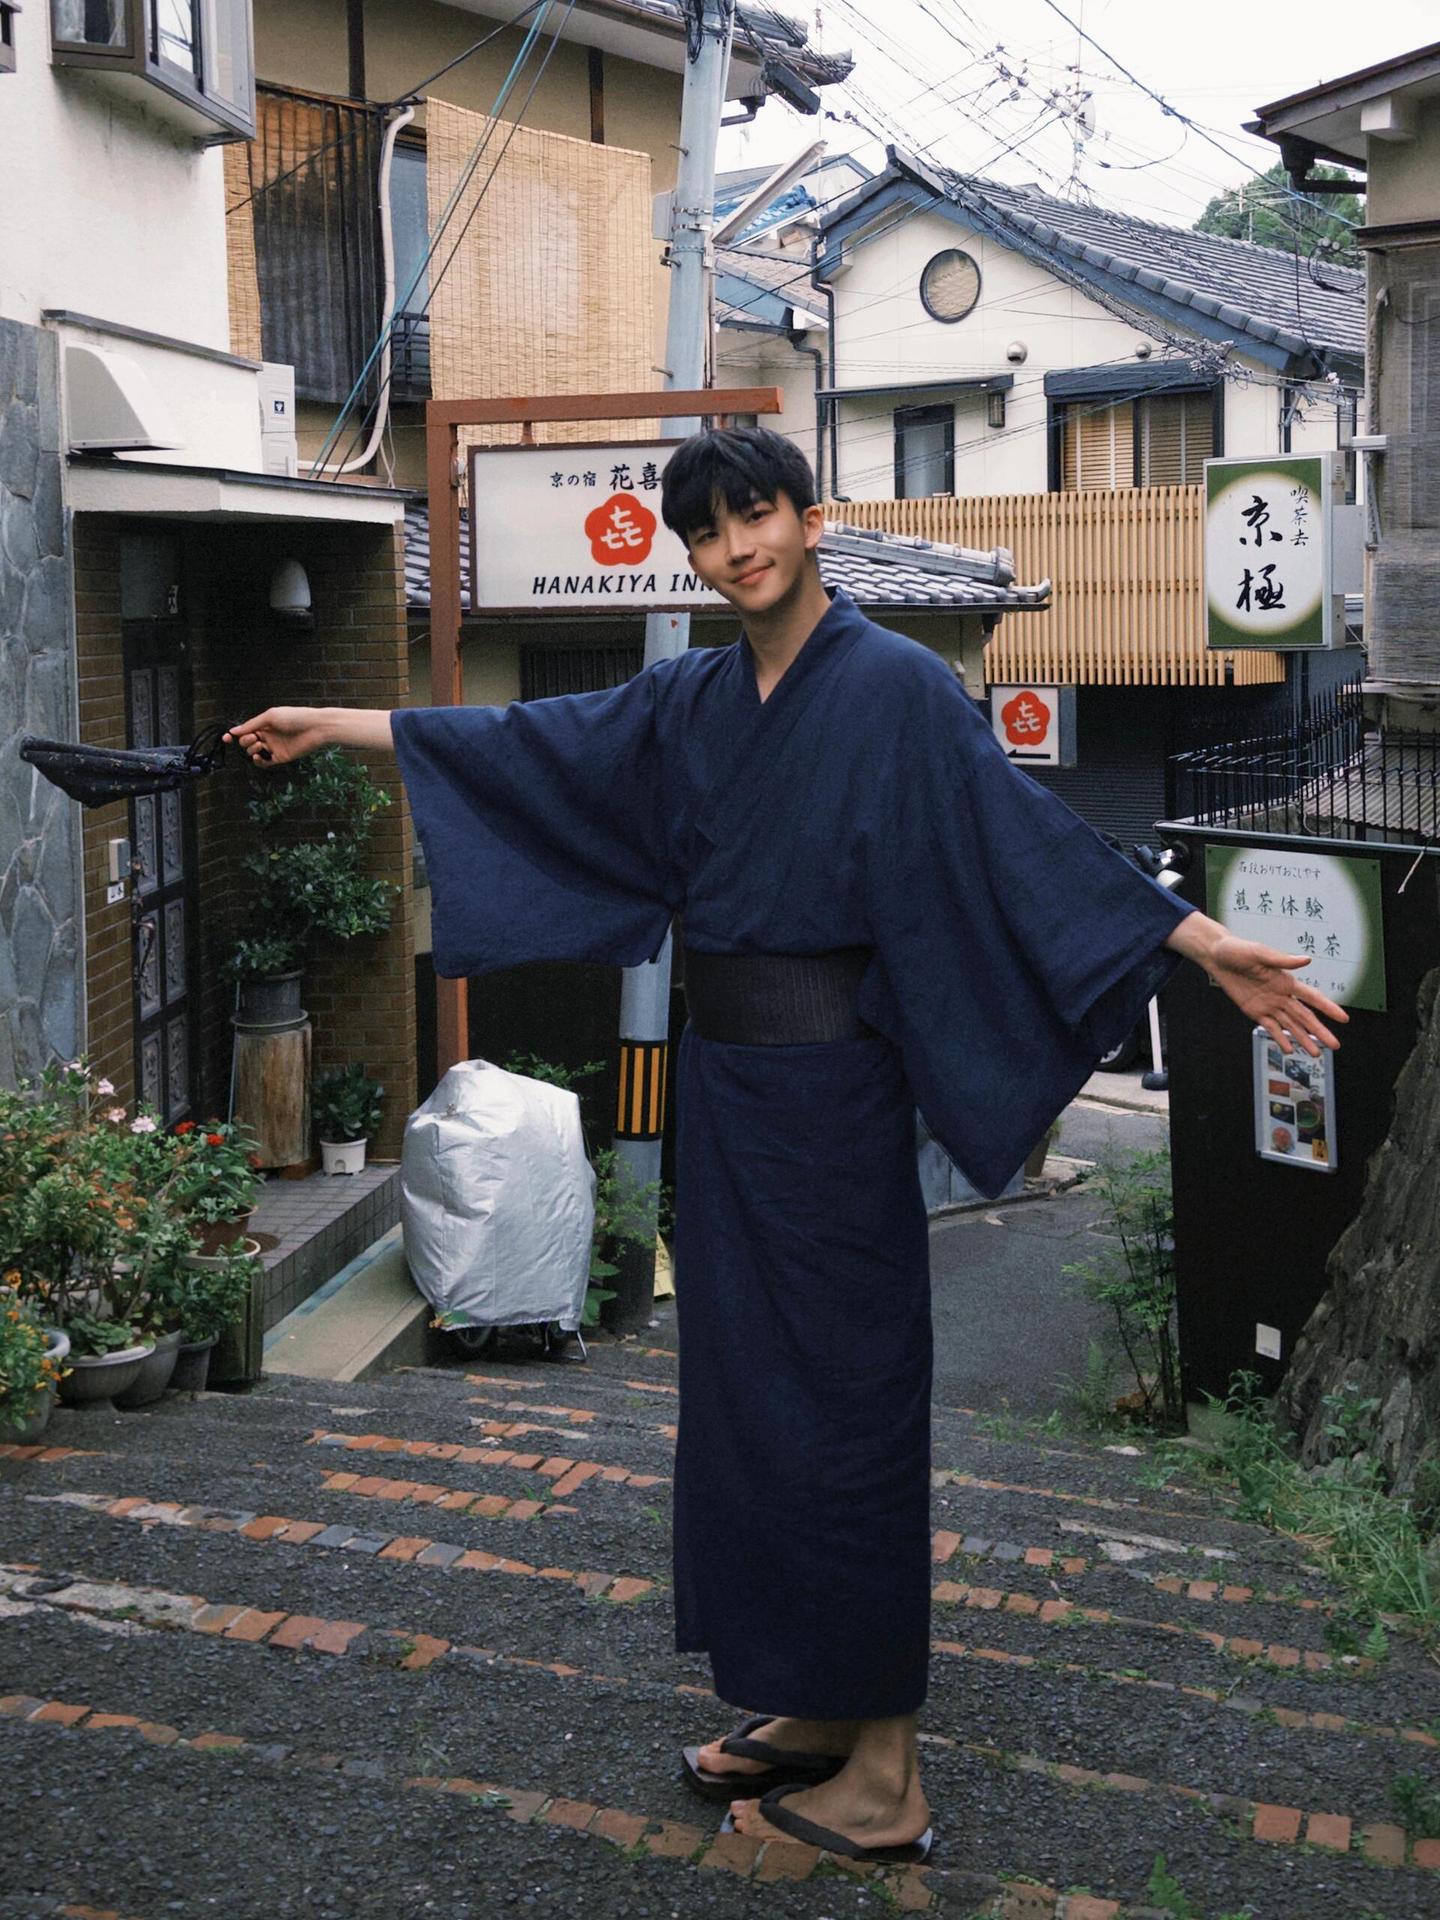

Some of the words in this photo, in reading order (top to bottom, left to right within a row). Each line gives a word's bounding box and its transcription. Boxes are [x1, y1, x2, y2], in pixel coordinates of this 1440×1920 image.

[550, 471, 597, 488] 京の宿
[609, 462, 662, 491] 花喜
[1289, 484, 1310, 547] 喫茶去
[1236, 495, 1287, 612] 京極
[532, 573, 656, 594] HANAKIYA
[1297, 931, 1341, 957] 喫茶
